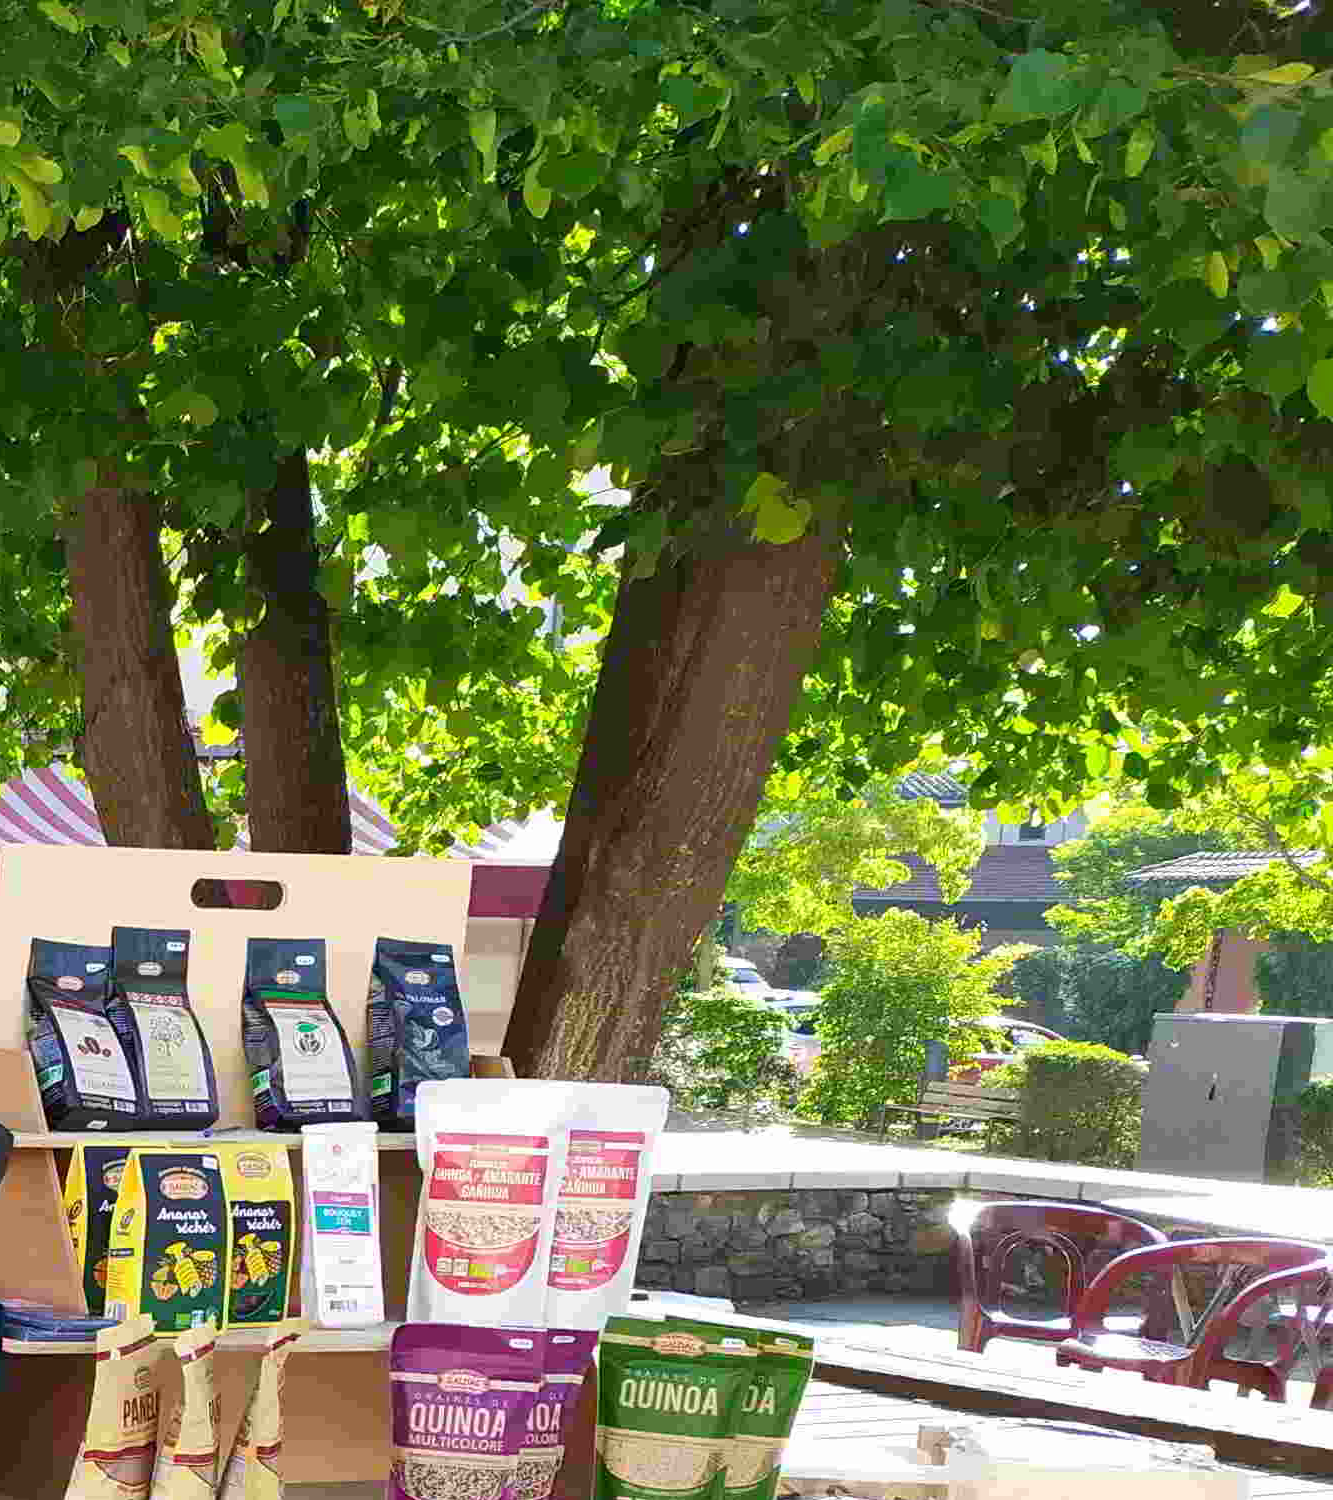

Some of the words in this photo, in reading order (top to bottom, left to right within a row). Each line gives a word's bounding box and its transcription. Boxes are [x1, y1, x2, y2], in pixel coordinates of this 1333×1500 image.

[156, 1207, 208, 1221] Ananas
[619, 1378, 719, 1416] QUINOA
[408, 1402, 507, 1438] QUINOA
[408, 1434, 506, 1453] MULTICOLORE
